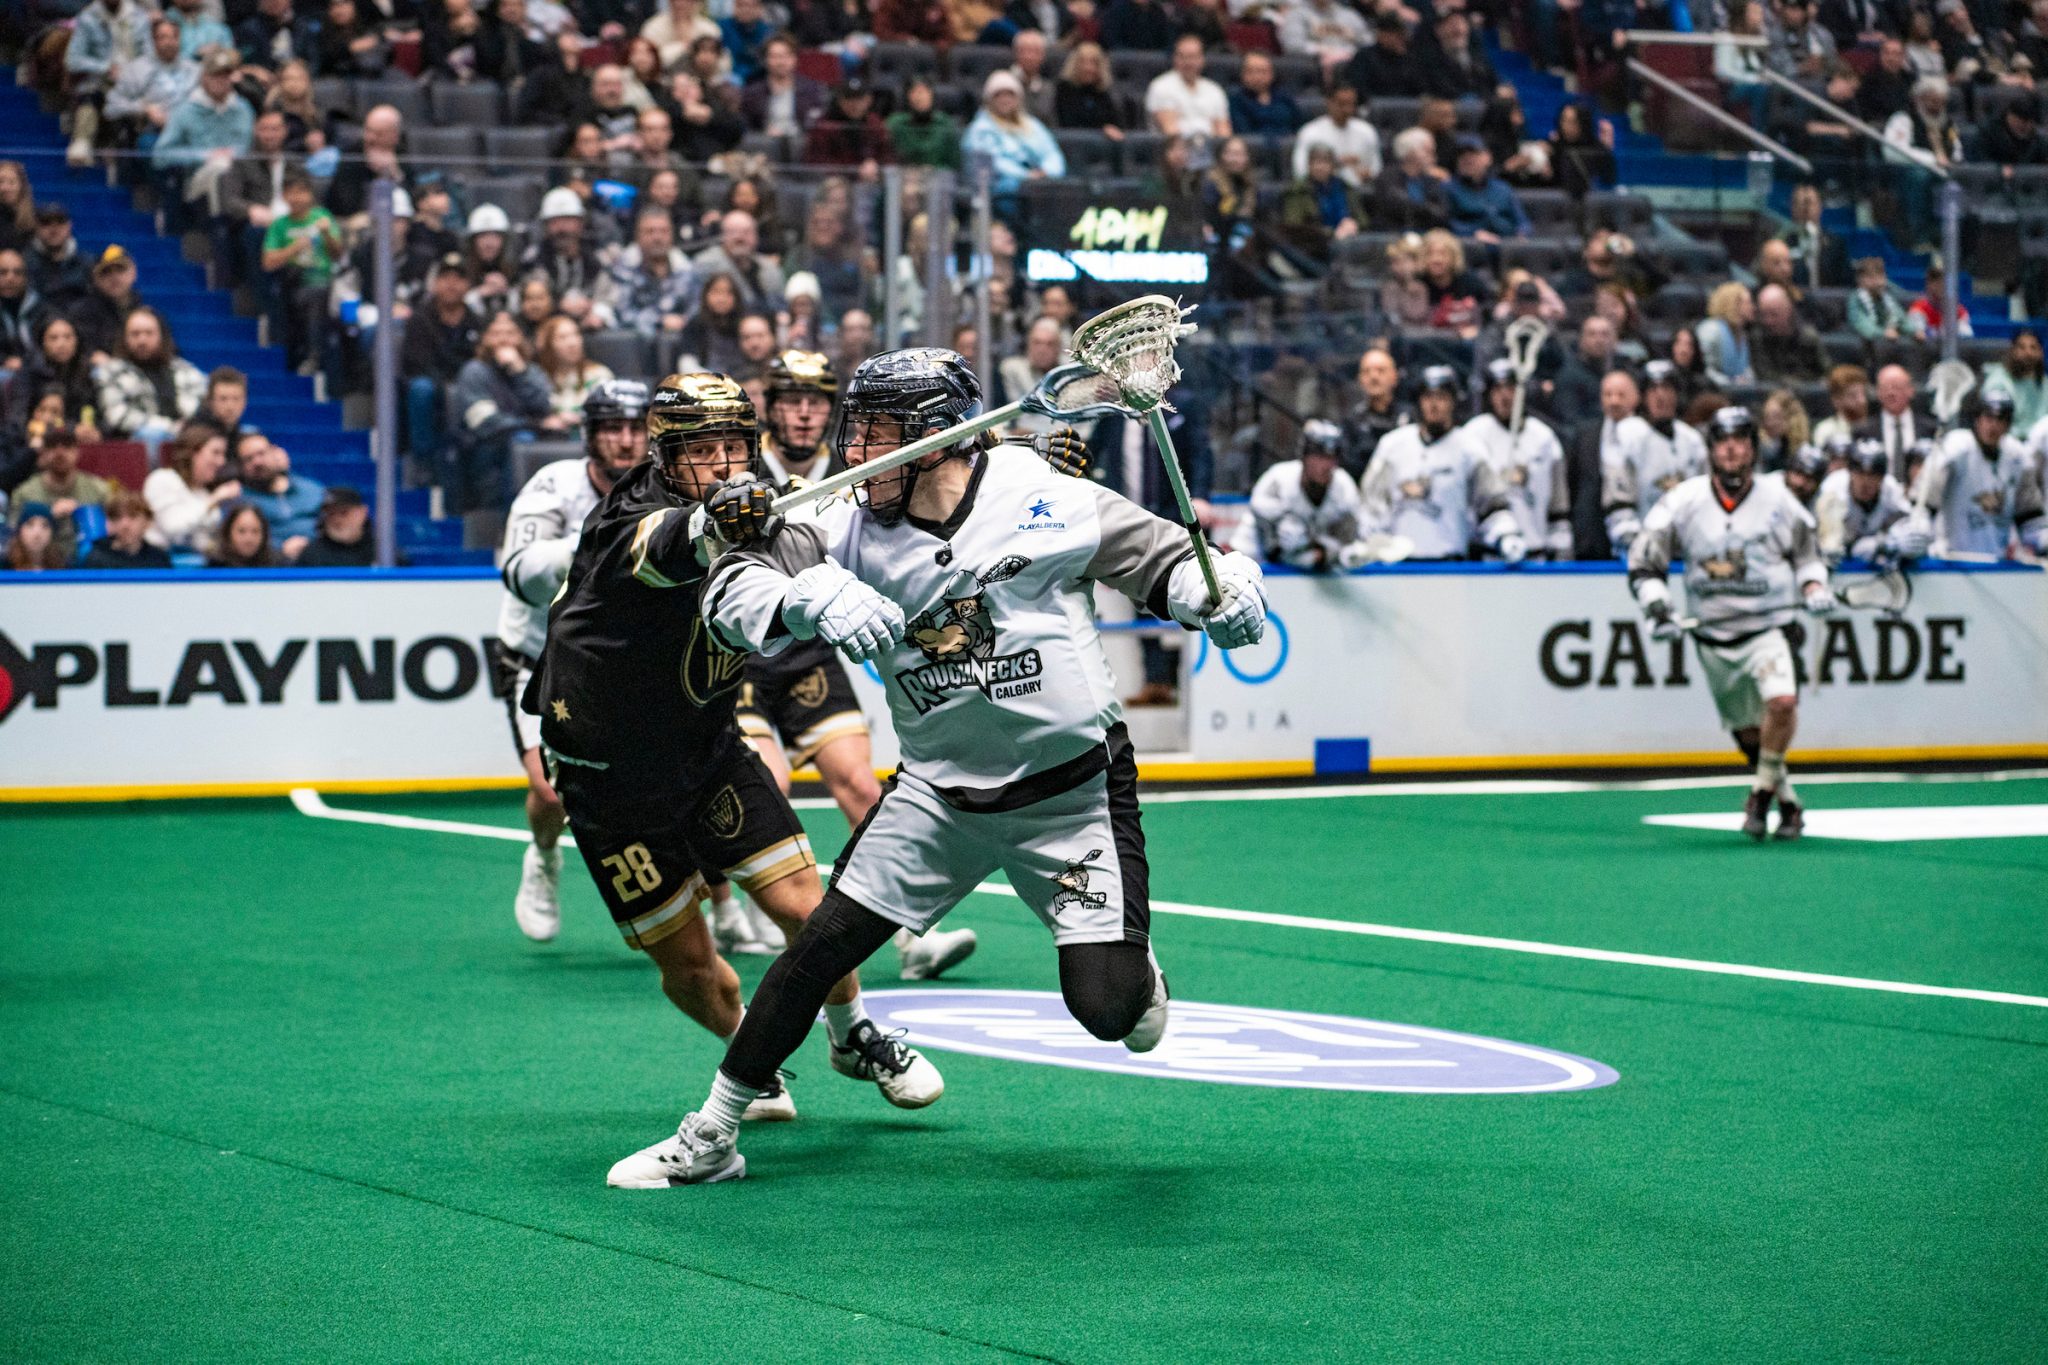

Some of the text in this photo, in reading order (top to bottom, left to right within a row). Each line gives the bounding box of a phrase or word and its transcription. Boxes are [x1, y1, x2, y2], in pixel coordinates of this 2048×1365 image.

[512, 522, 536, 548] 19
[32, 633, 512, 710] PLAYNO
[894, 648, 1043, 716] ROUGHNECKS
[1538, 617, 1967, 690] GATADE
[995, 680, 1042, 700] CALGARY
[601, 841, 663, 903] 28
